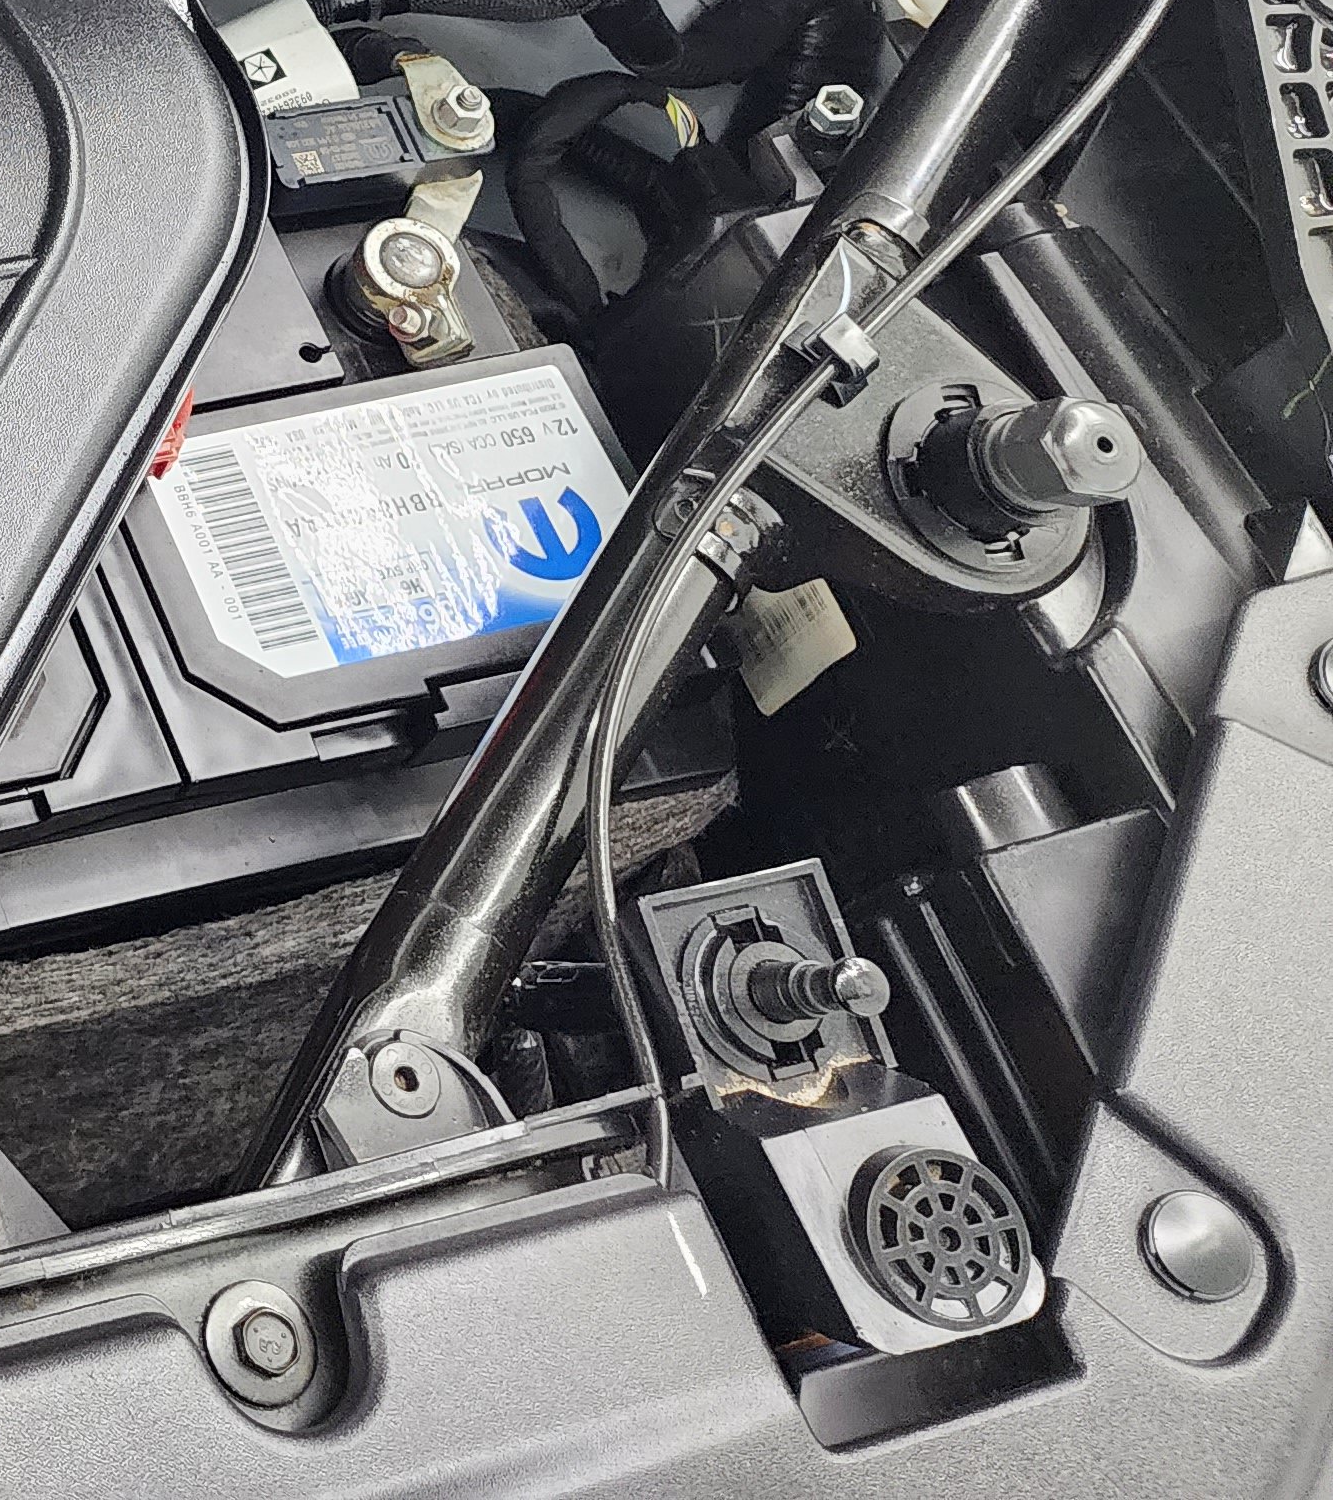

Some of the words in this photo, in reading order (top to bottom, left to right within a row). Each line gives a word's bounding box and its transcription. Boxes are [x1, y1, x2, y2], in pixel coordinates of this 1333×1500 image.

[466, 432, 497, 451] CCA
[499, 425, 535, 448] 650
[372, 454, 392, 470] Ah
[462, 462, 571, 495] MOPAR
[173, 485, 195, 518] BBH6
[190, 523, 213, 554] A001
[206, 559, 224, 579] AA
[223, 595, 242, 621] 001
[397, 576, 424, 596] H6
